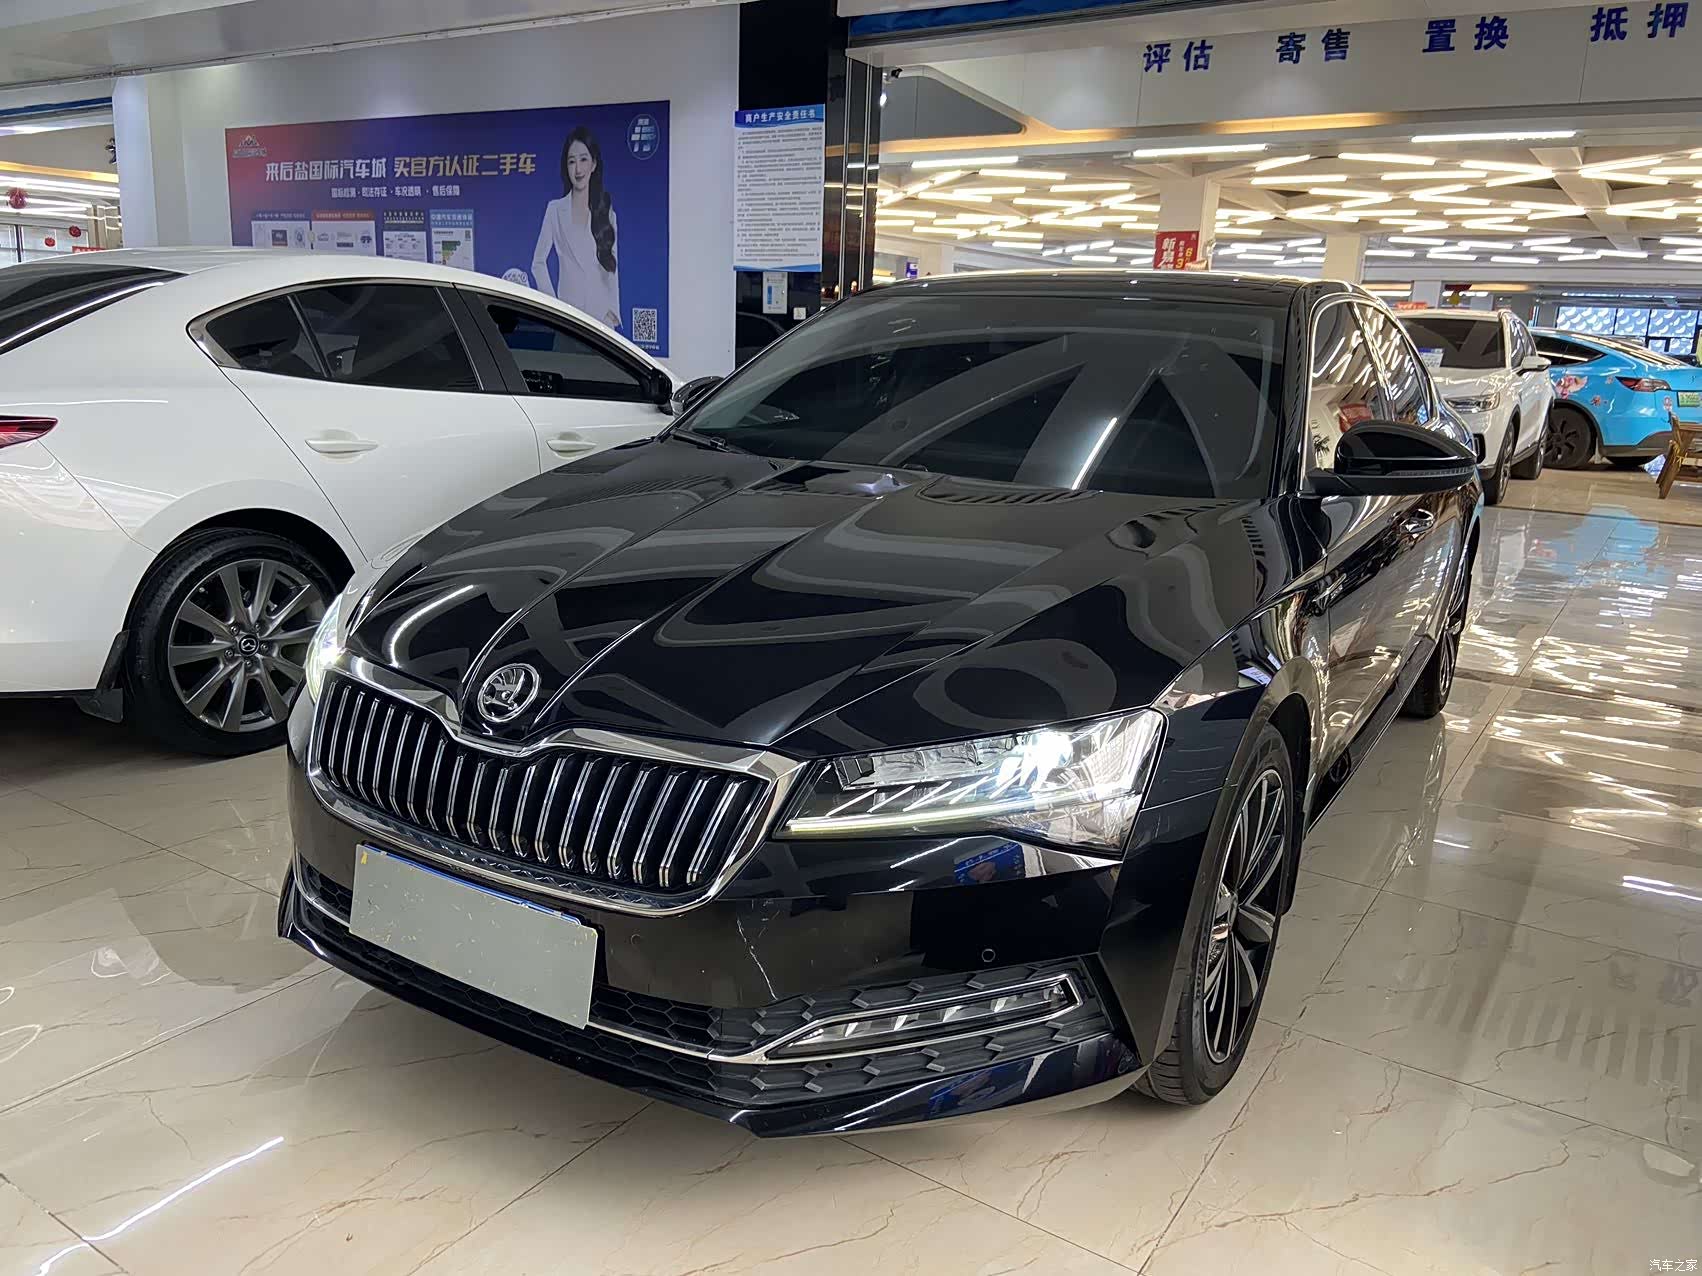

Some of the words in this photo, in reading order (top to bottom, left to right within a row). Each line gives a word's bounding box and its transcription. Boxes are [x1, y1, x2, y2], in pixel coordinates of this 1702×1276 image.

[1143, 40, 1213, 73] 评估
[1276, 28, 1350, 64] 寄售
[1422, 16, 1509, 53] 置换
[1590, 2, 1689, 42] 抵押
[745, 109, 816, 124] 商户生产安全责任书
[265, 157, 387, 182] 来后盐国际汽车城
[393, 153, 537, 178] 买官方认证二手车
